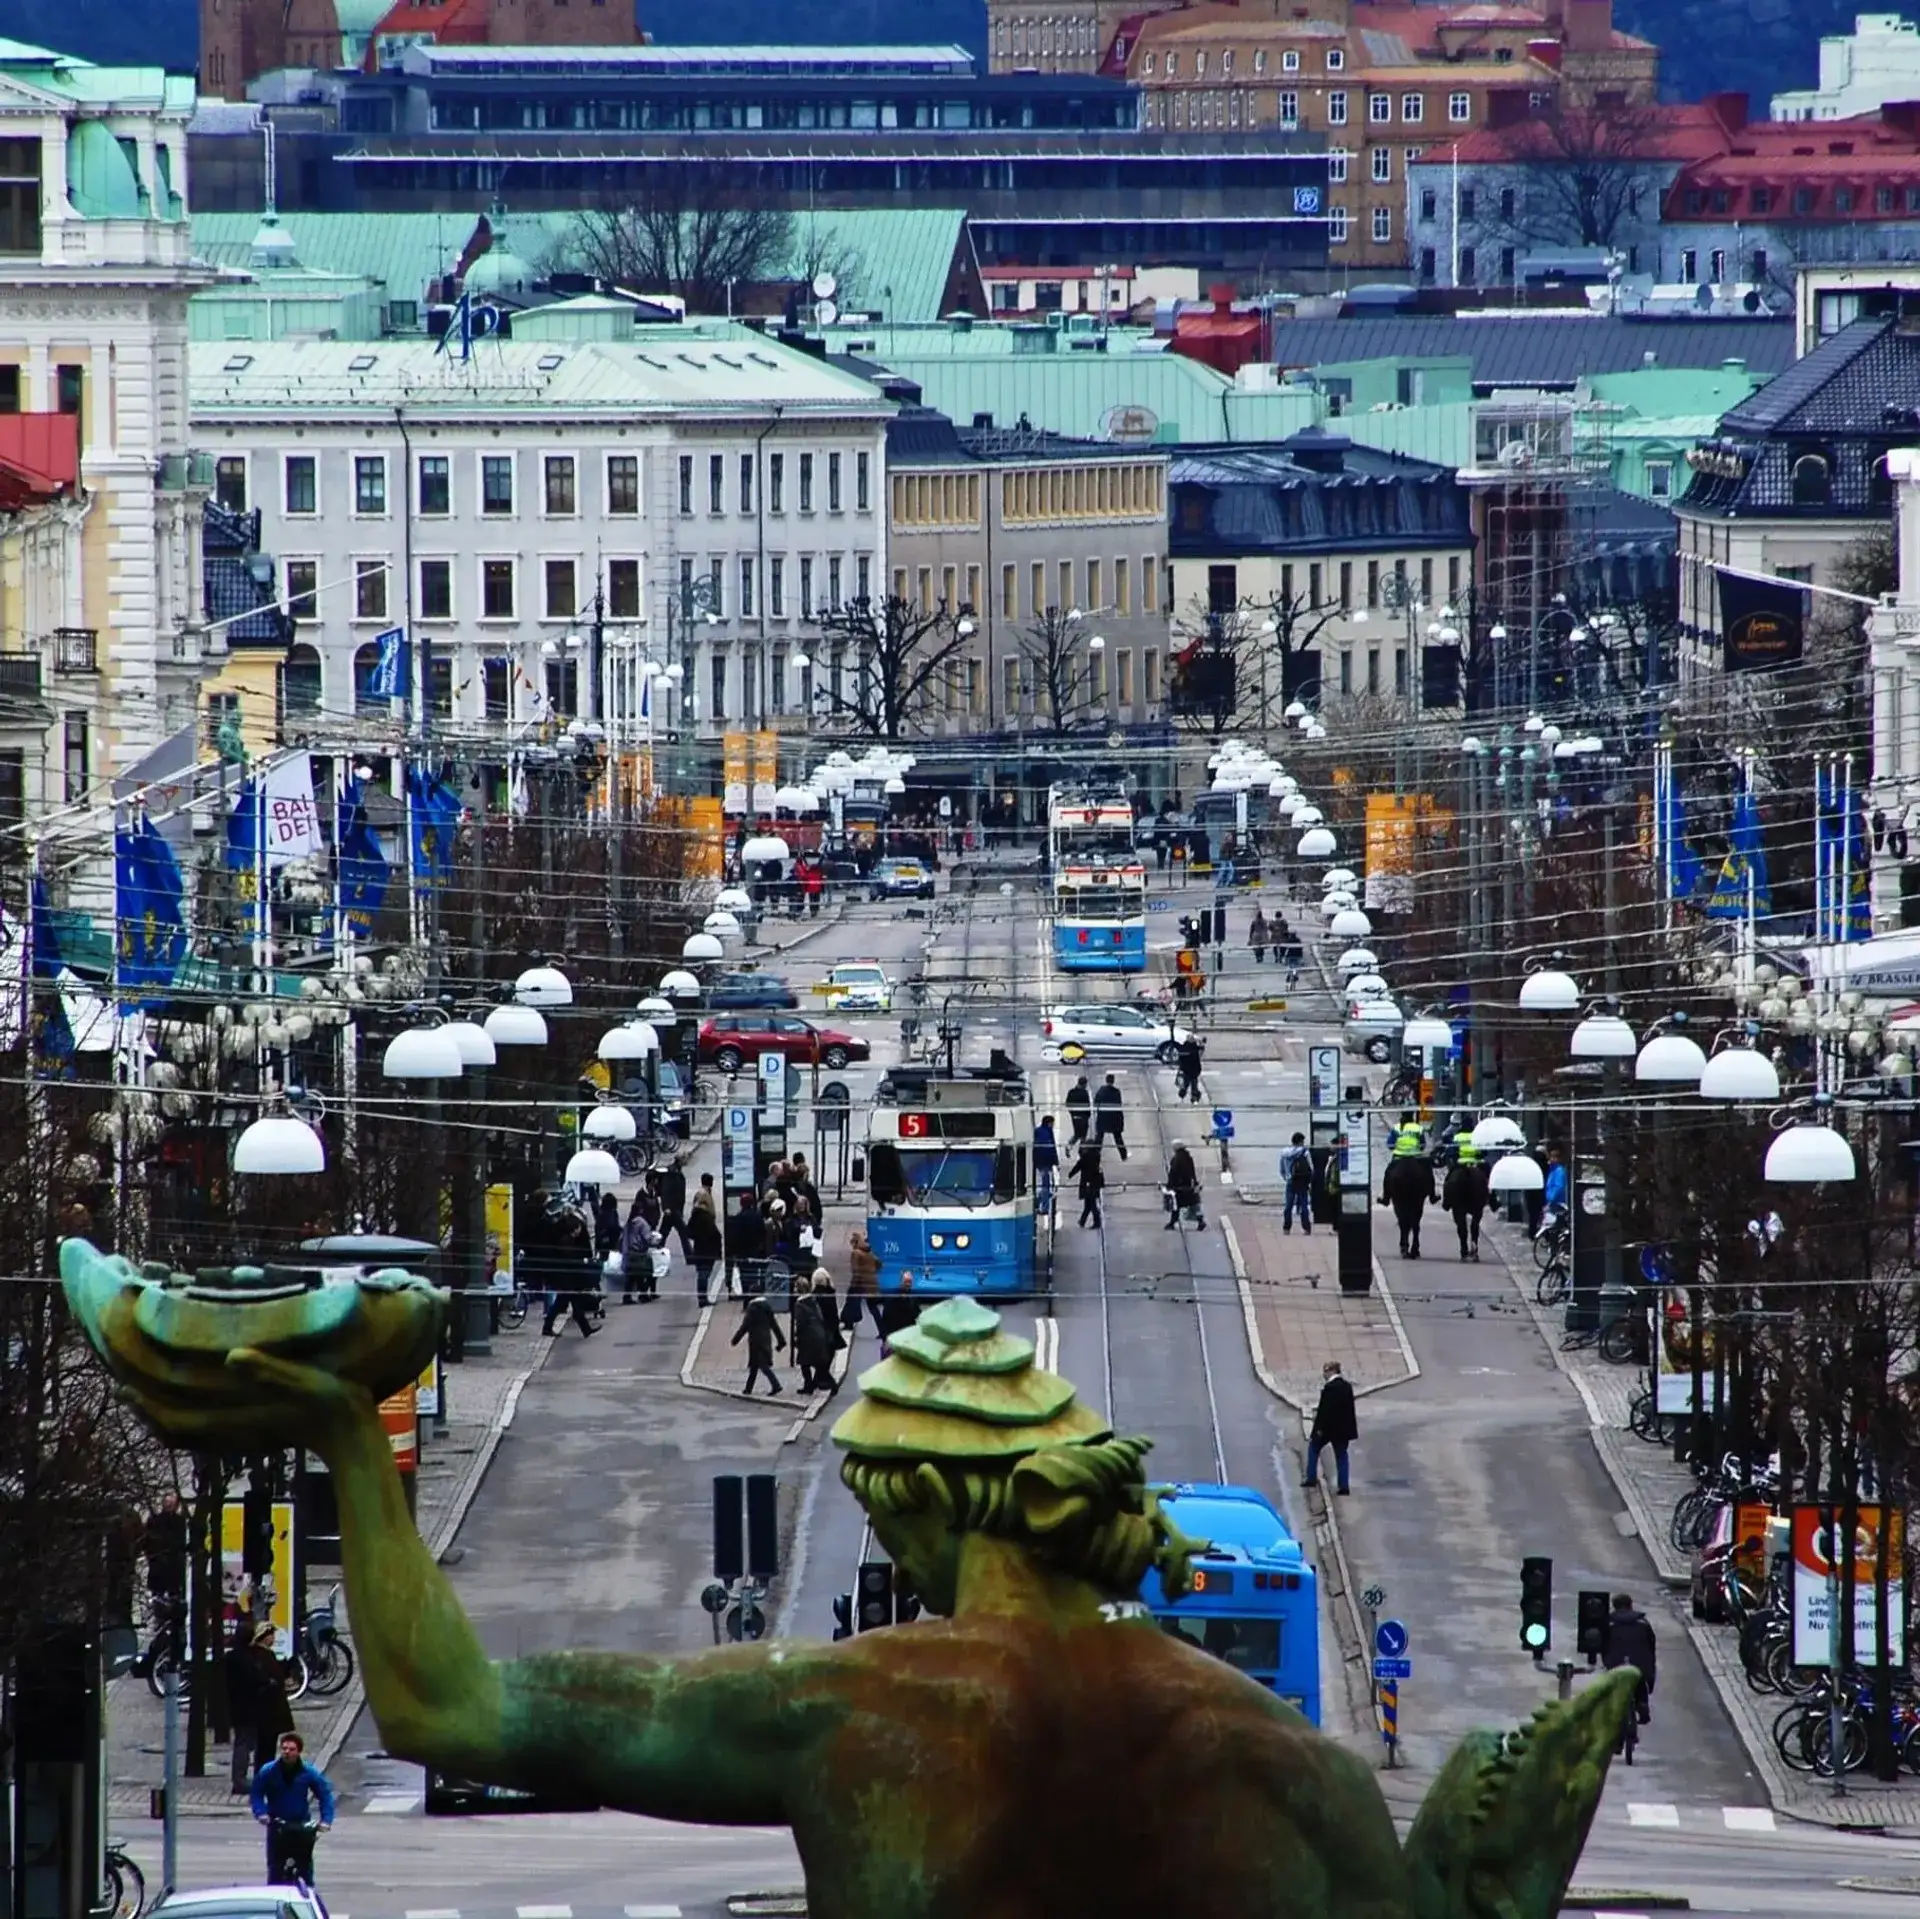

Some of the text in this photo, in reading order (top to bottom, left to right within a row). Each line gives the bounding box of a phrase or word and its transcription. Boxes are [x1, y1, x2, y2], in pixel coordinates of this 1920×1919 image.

[765, 1056, 780, 1073] D
[1318, 1050, 1332, 1067] C
[731, 1109, 746, 1128] D
[907, 1115, 921, 1136] 5
[1808, 1620, 1825, 1630] Nu
